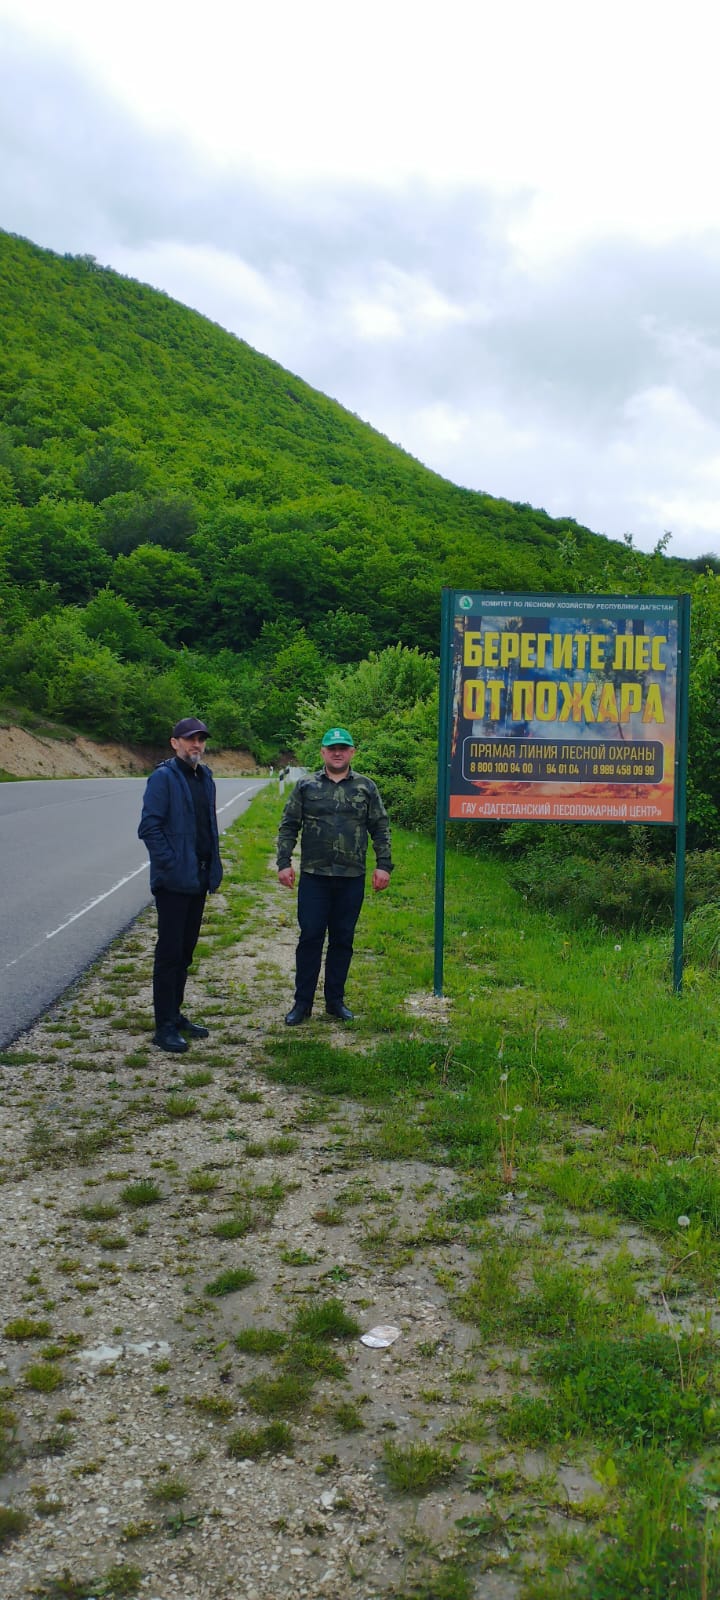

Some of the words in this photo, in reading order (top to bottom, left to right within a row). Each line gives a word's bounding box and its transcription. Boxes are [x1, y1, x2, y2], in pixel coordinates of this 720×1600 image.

[557, 601, 595, 609] ХОЗЯЙСТВУ
[463, 631, 606, 669] БЕРЕГИТЕ
[612, 634, 667, 671] ЛЕС
[463, 679, 505, 721] ОТ
[512, 680, 665, 723] ПОЖАРА
[470, 743, 516, 758] ПРЯМАЯ
[519, 744, 558, 759] ЛИНИЯ
[561, 744, 606, 760] ЛЕСНОЙ
[609, 746, 655, 761] ОХРАНЫ
[470, 761, 476, 772] 8
[494, 762, 509, 773] 100
[510, 762, 521, 774] 94
[522, 763, 533, 774] 00
[546, 763, 557, 774] 94
[558, 763, 567, 775] 01
[568, 763, 579, 774] 04
[592, 764, 599, 775] 8
[461, 802, 477, 814] ГАУ
[478, 802, 551, 816] «ДАГЕСТАНСКИЙ
[553, 803, 627, 817] ЛЕСОПОЖАРНЫЙ
[629, 805, 662, 817] ЦЕНТР»
